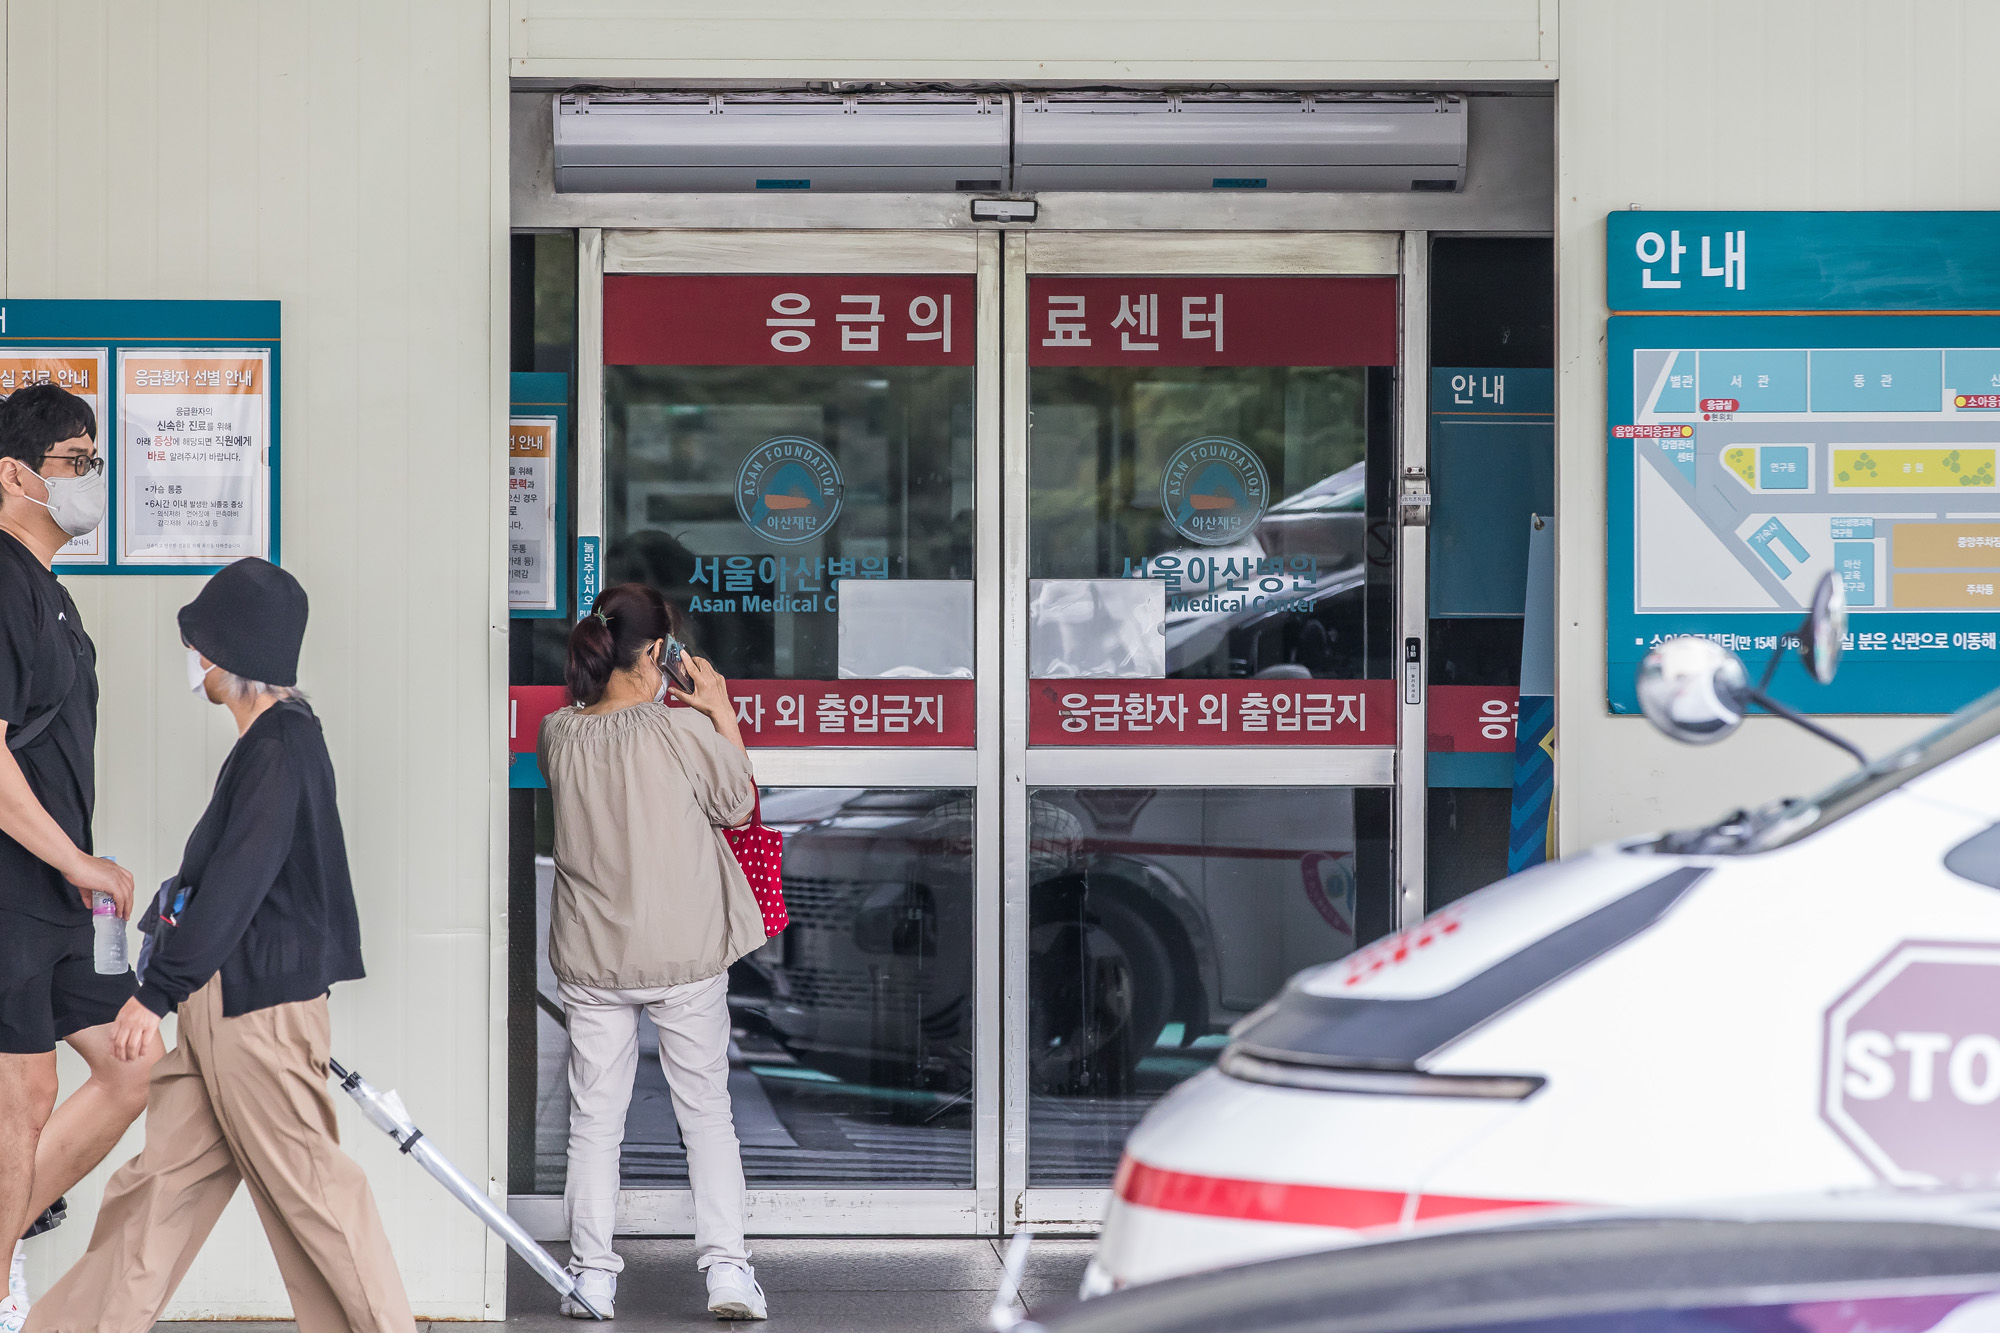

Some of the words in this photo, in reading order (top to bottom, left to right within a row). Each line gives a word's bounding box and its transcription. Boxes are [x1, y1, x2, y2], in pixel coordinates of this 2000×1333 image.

[1636, 230, 1746, 291] 안내
[58, 369, 89, 388] 안내
[134, 369, 190, 387] 응급환자
[194, 369, 220, 387] 선별
[225, 369, 252, 387] 안내
[1670, 375, 1694, 388] 별관
[1451, 374, 1505, 405] 안내
[1706, 400, 1733, 411] 응급실
[1967, 395, 2000, 408] 소아응
[176, 407, 213, 416] 응급환자의
[1711, 413, 1733, 422] 현위치
[157, 420, 185, 431] 신속한
[188, 420, 214, 431] 진료를
[217, 422, 232, 431] 위해
[1615, 426, 1681, 438] 음압격리응급실
[136, 437, 151, 446] 아래
[154, 435, 180, 446] 증상에
[182, 437, 212, 446] 해당되면
[215, 435, 252, 446] 직원에게
[518, 435, 543, 450] 안내
[1661, 440, 1694, 450] 감염관리
[147, 451, 166, 461] 바로
[169, 452, 207, 461] 알려주시기
[1677, 453, 1694, 462] 센터
[518, 467, 533, 475] 위해
[744, 461, 764, 496] ASAN
[764, 445, 835, 496] FOUNDATION
[1169, 461, 1189, 496] ASAN
[1190, 445, 1260, 496] FOUNDATION
[1770, 462, 1797, 473] 연구동
[150, 485, 165, 494] 가슴
[168, 485, 182, 494] 통증
[149, 500, 170, 509] 6시간
[172, 500, 188, 508] 이내
[523, 494, 538, 503] 경우
[767, 516, 817, 530] 아산재단
[1192, 516, 1241, 530] 아산재단
[1755, 522, 1779, 543] 기숙사
[511, 544, 526, 554] 두통
[583, 542, 595, 605] 눌러주십시오
[1121, 555, 1317, 593] 서울아산병원
[1966, 584, 1994, 595] 주차동
[688, 595, 736, 613] Asan
[742, 594, 818, 613] Medical
[1171, 594, 1246, 613] Medical
[1252, 595, 1317, 613] Center
[1754, 635, 1777, 650] 15세
[1857, 632, 1888, 650] 분은
[1890, 632, 1949, 650] 신관으로
[1952, 632, 1997, 650] 이동해
[774, 694, 804, 732] 외
[816, 693, 943, 732] 출입금지
[1058, 693, 1189, 733] 응급환자
[1197, 693, 1228, 732] 외
[1239, 692, 1366, 732] 출입금지
[1843, 1030, 2000, 1104] STO
